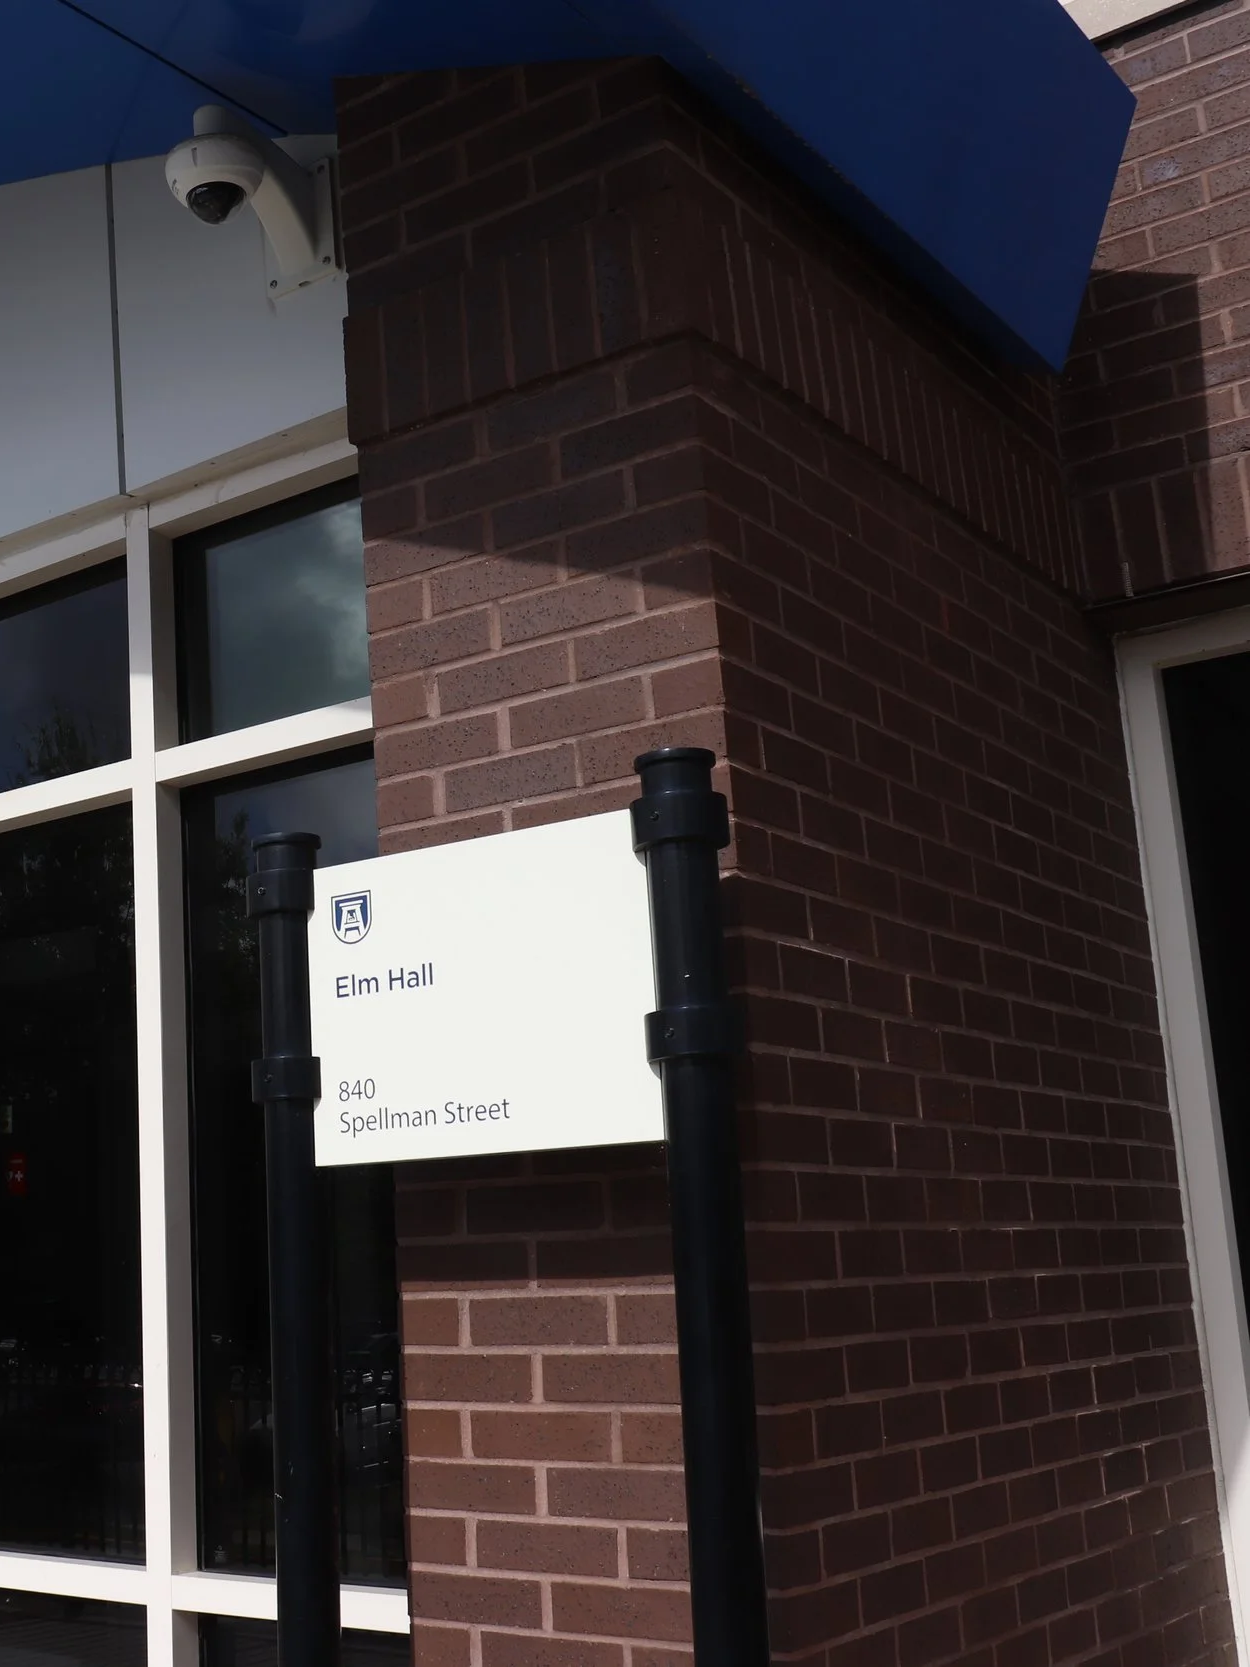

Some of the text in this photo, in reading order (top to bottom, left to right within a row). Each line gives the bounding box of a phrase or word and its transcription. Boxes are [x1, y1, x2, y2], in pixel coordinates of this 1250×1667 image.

[335, 962, 434, 998] Elm Hall
[338, 1078, 376, 1102] 840
[339, 1098, 510, 1138] Spellman Street
